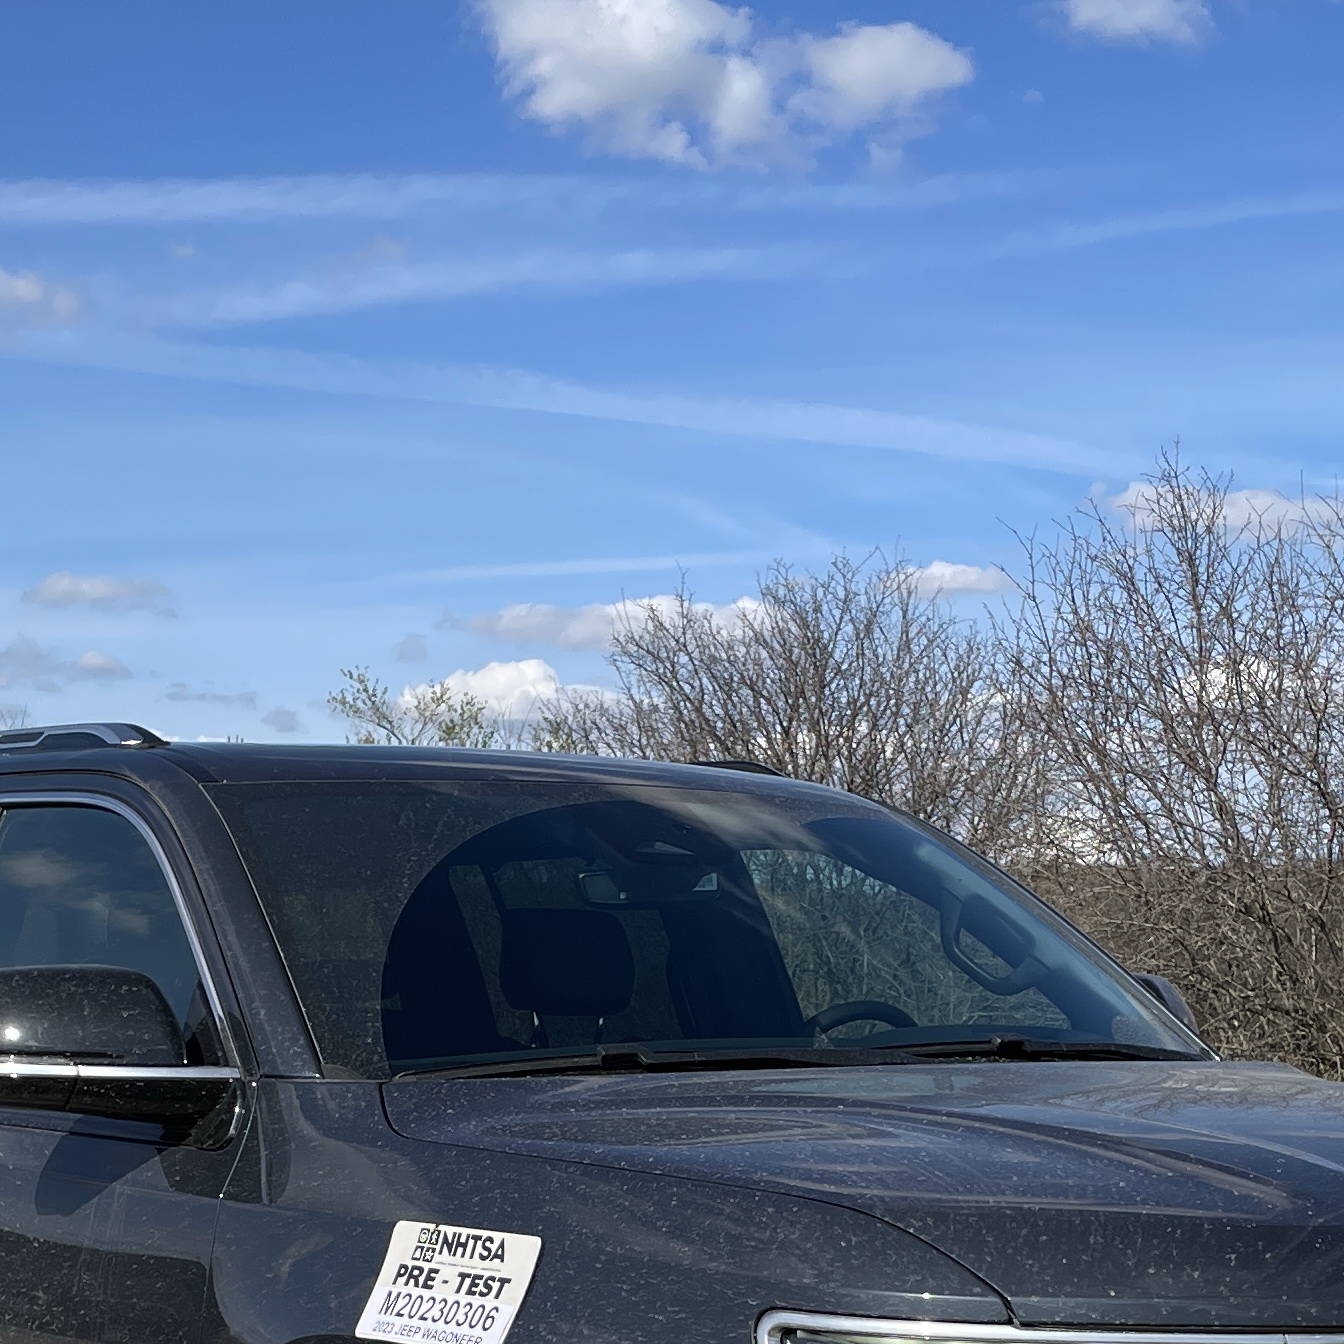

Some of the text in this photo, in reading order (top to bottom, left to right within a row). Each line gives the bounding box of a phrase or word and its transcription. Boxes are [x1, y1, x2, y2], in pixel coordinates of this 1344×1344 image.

[438, 1231, 505, 1263] NHTSA
[392, 1264, 440, 1290] PRE
[454, 1272, 512, 1300] TEST
[378, 1290, 500, 1332] M20230306
[372, 1321, 396, 1334] 2023
[395, 1324, 422, 1338] JEEP
